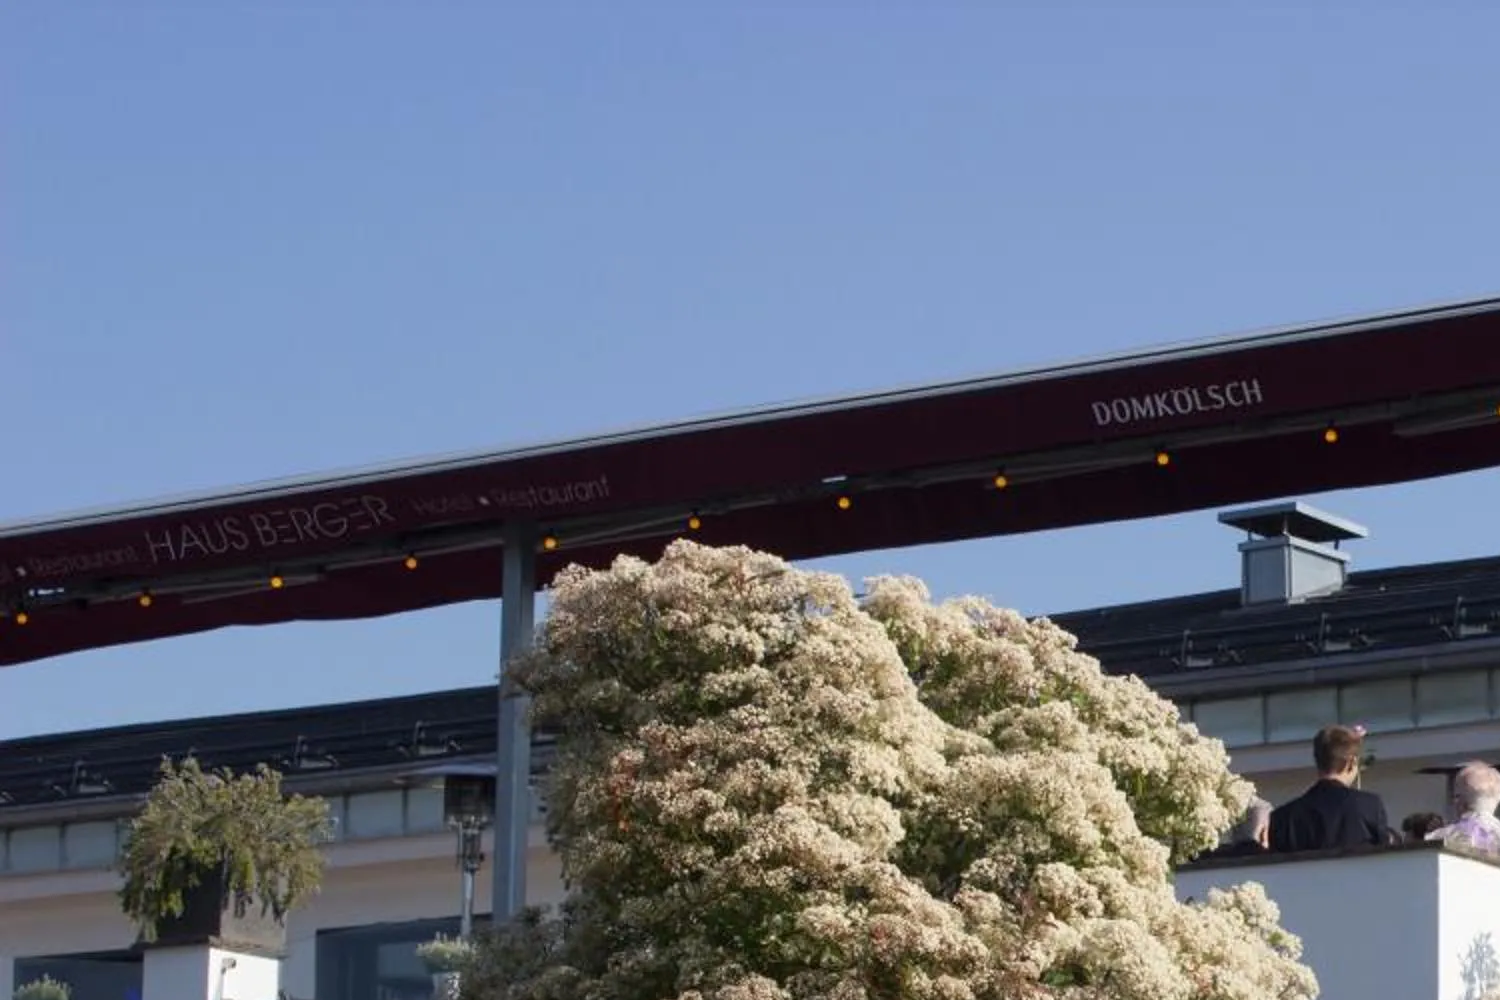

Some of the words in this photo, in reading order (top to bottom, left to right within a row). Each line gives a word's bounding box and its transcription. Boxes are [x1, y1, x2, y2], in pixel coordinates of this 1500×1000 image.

[1091, 378, 1264, 426] DOMKÖLSCH
[144, 515, 250, 565] HAUS
[250, 494, 397, 547] BERGER
